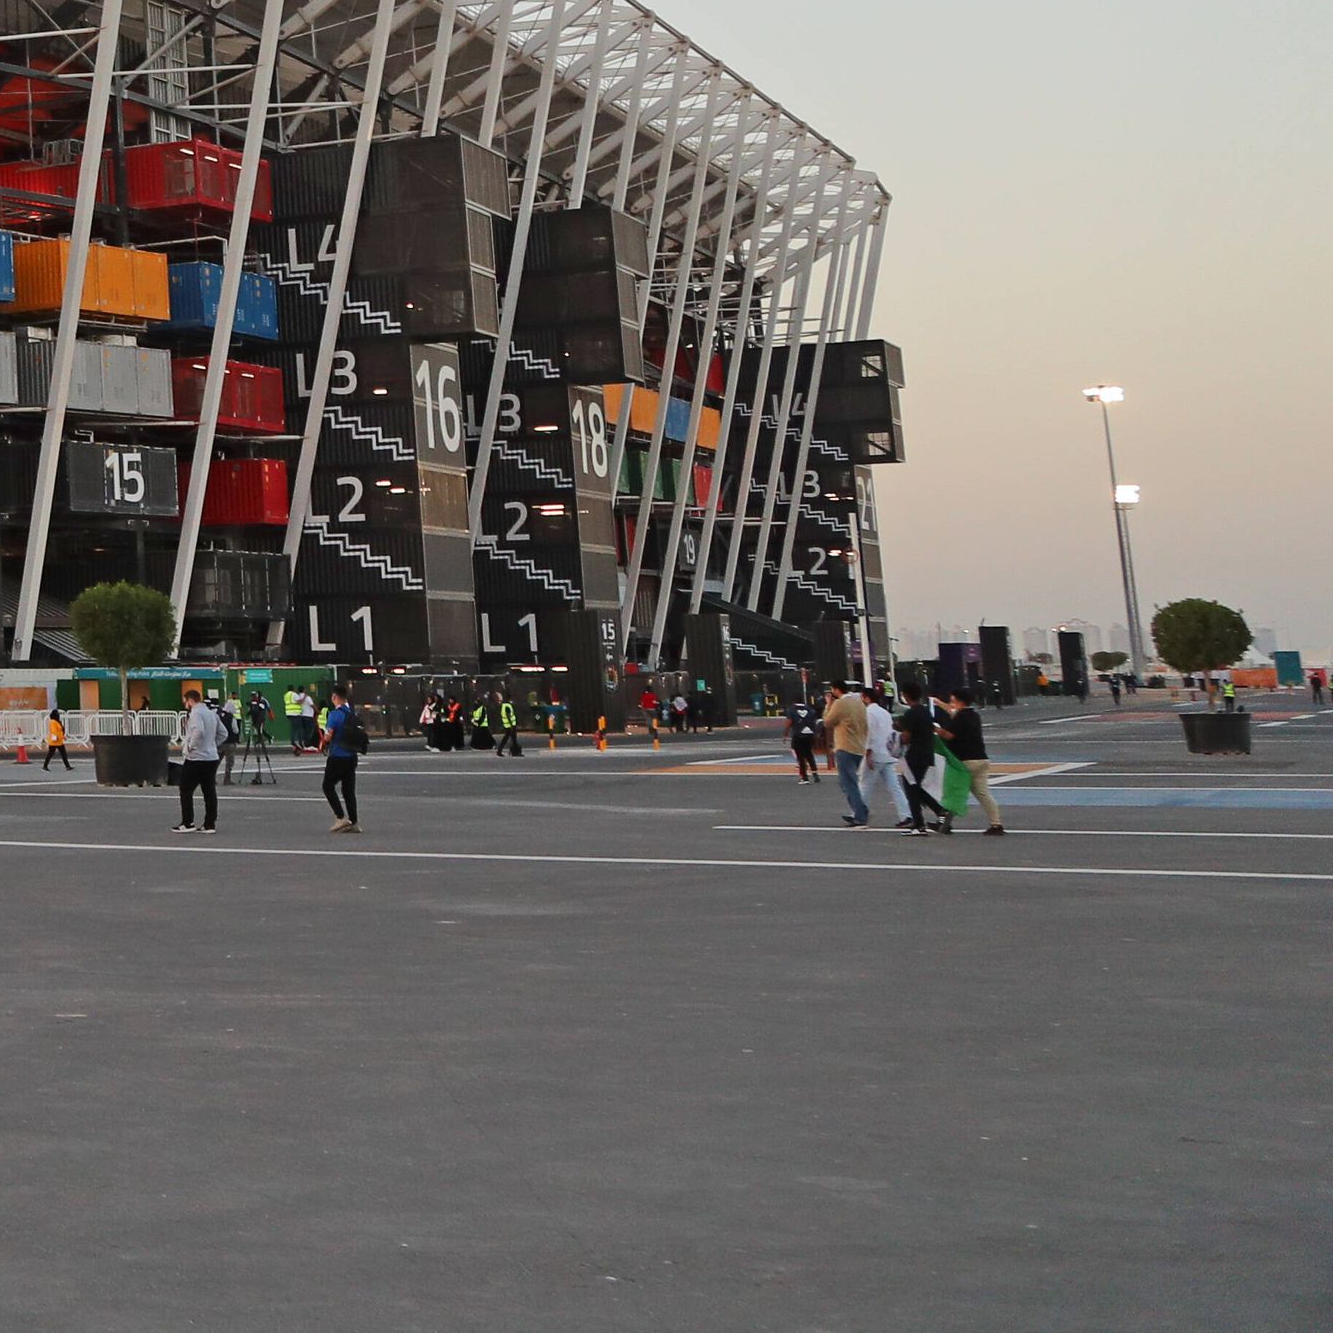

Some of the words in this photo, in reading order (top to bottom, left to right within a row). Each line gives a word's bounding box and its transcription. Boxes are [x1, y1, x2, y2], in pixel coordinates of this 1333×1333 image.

[296, 350, 358, 398] L3
[416, 360, 461, 453] 16
[467, 393, 522, 436] L3
[572, 399, 608, 478] 18
[105, 452, 145, 503] 15
[779, 470, 821, 498] L3
[857, 475, 877, 531] 21
[684, 533, 696, 565] 19
[601, 622, 616, 641] 15
